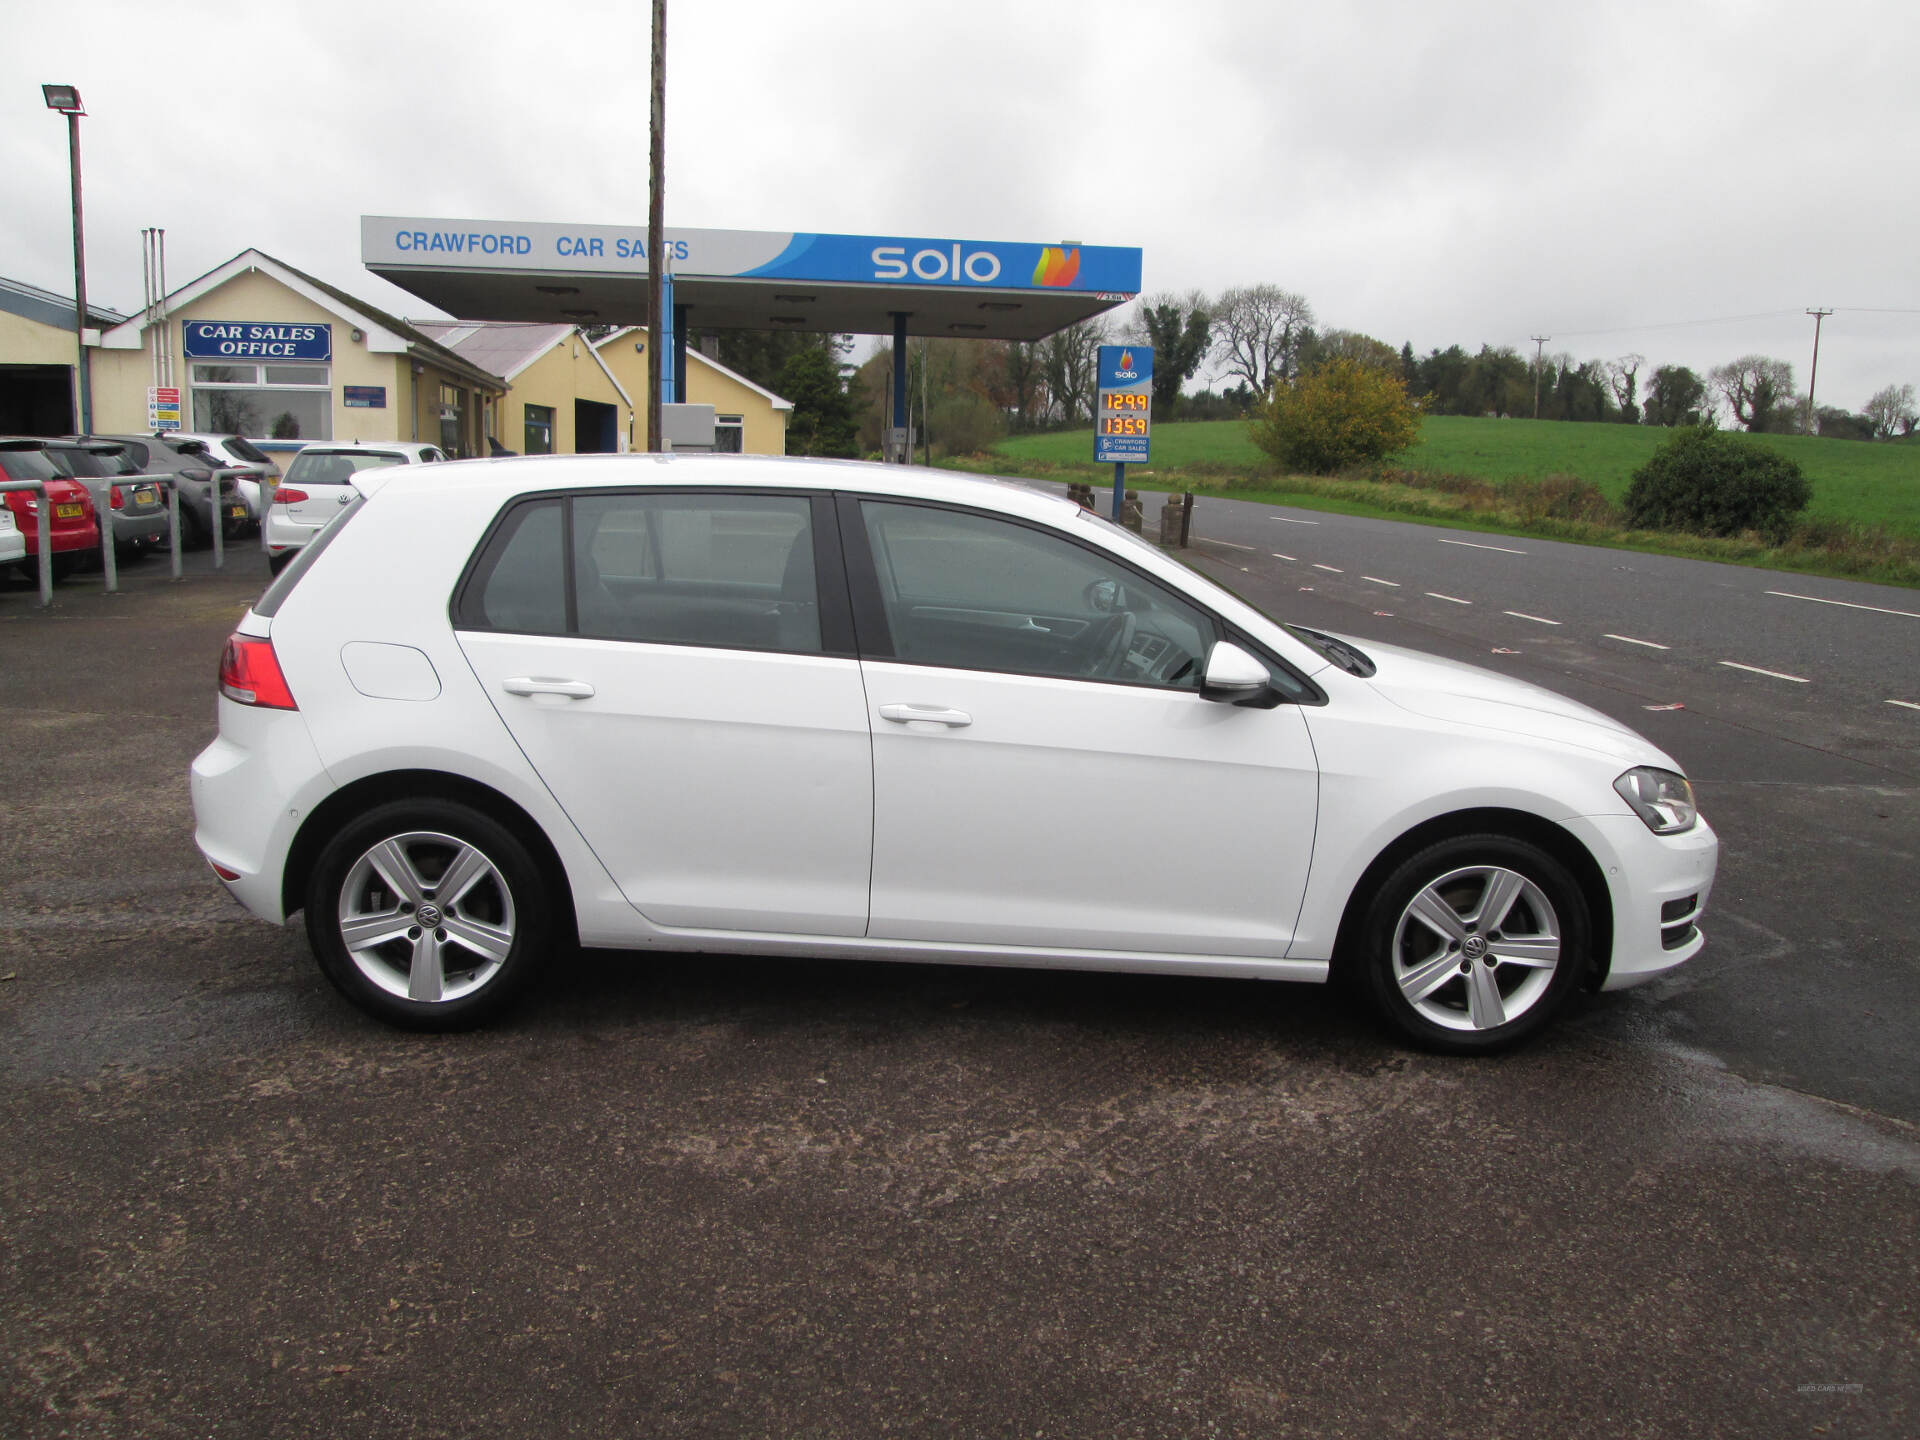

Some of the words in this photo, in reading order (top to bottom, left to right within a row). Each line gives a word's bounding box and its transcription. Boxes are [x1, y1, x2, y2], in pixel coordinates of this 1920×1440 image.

[395, 230, 532, 255] CRAWFORD
[556, 236, 604, 257] CAR
[616, 238, 689, 260] SAES
[871, 243, 1001, 282] solo
[199, 325, 242, 339] CAR
[250, 327, 316, 341] SALES
[220, 341, 296, 356] OFFICE
